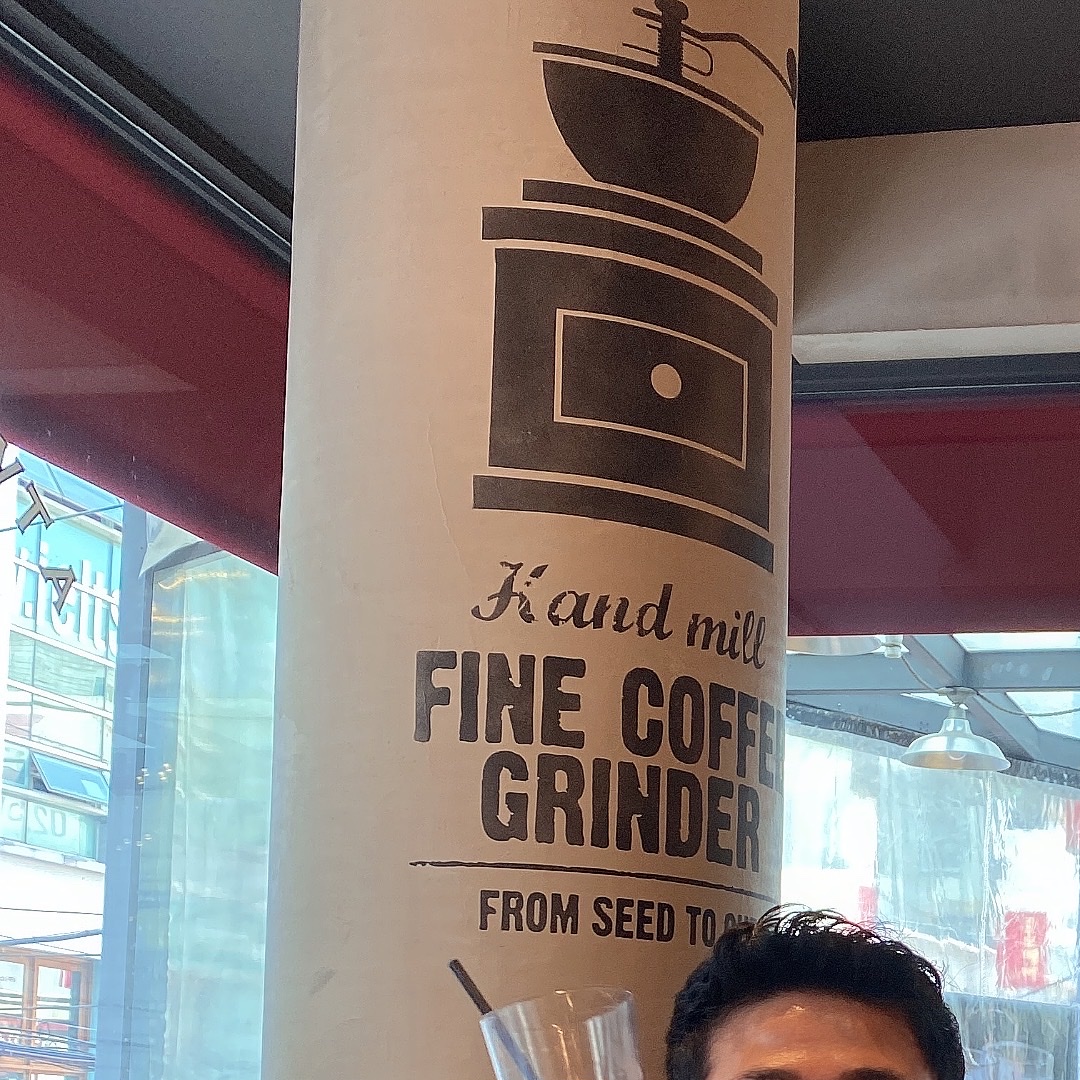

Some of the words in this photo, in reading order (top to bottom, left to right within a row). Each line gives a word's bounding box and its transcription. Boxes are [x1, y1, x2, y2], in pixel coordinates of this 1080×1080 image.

[687, 610, 766, 669] mill
[413, 650, 587, 749] FINE
[481, 750, 760, 873] GRINDER
[479, 889, 580, 935] FROM
[591, 896, 676, 943] SEED
[685, 905, 716, 948] TO
